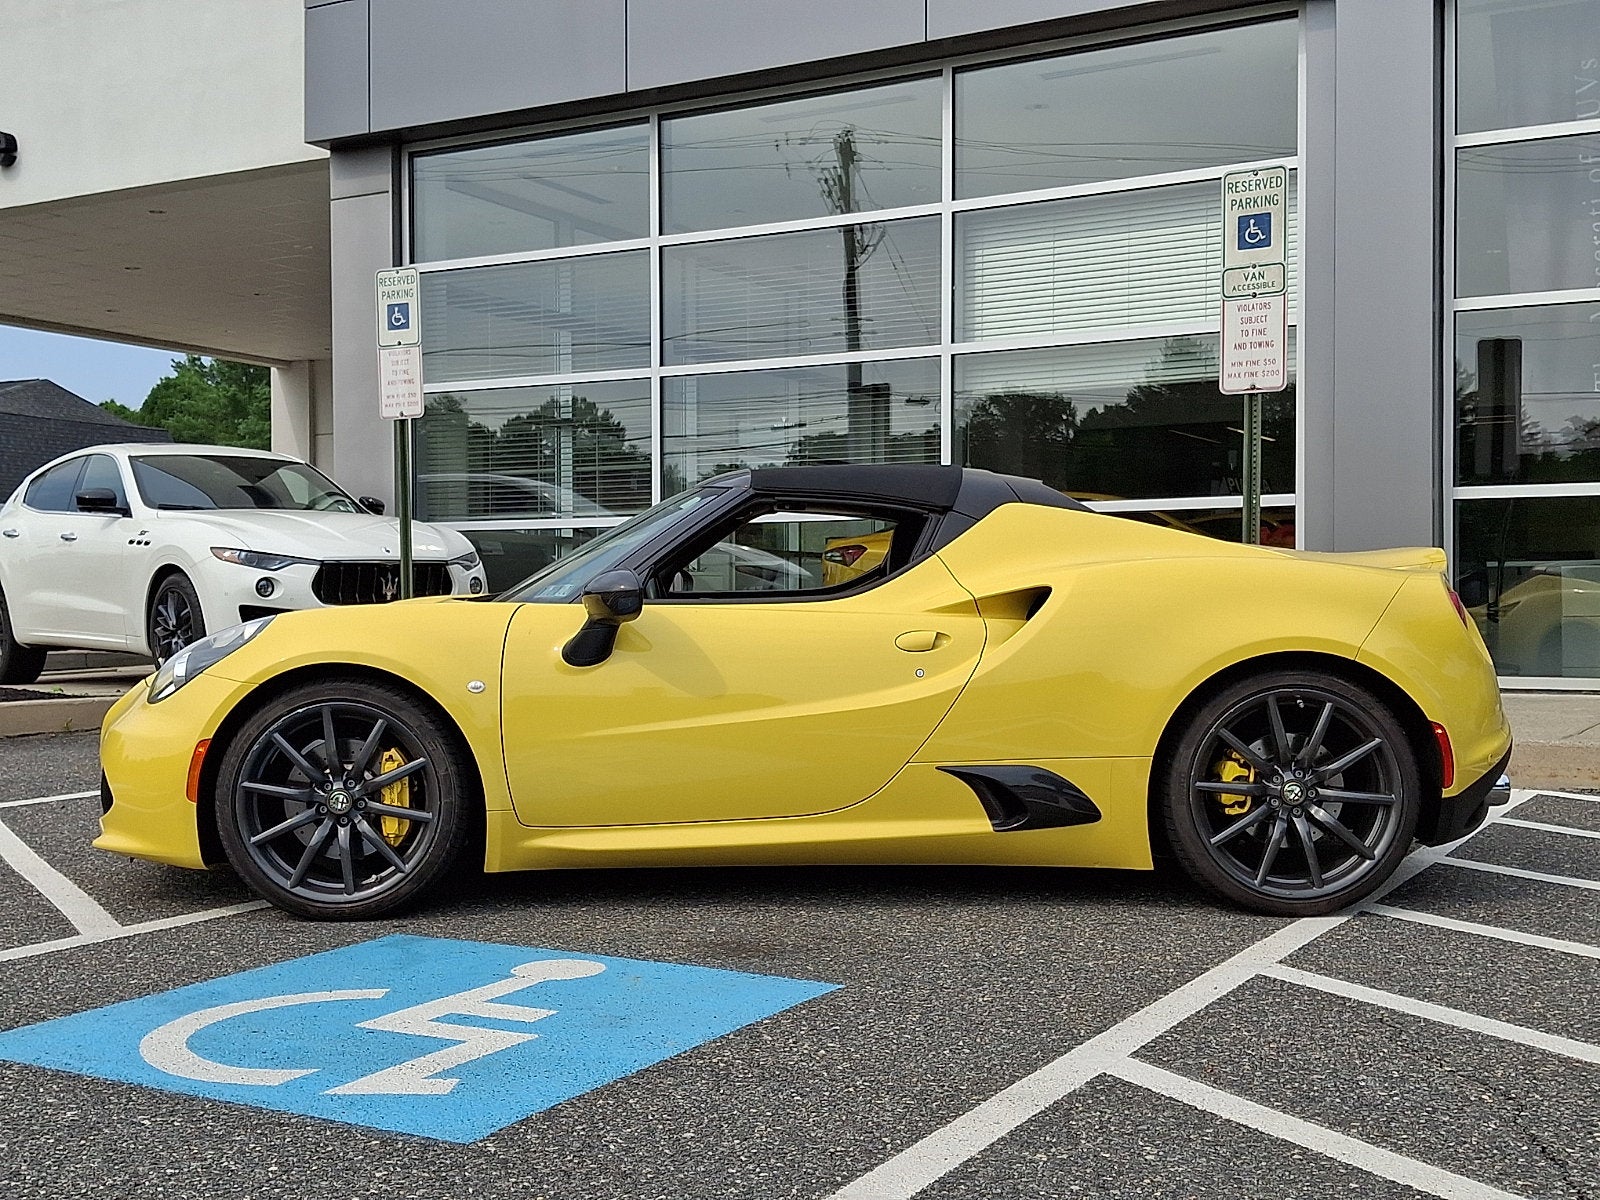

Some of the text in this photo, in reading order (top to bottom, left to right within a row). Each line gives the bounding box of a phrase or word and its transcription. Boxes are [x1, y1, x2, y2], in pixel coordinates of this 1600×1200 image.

[1227, 176, 1283, 194] RESERVED
[1231, 194, 1279, 211] PARKING
[379, 275, 415, 287] RESERVED
[1243, 271, 1265, 281] VAN
[1232, 281, 1276, 292] ACCESSIBLE
[382, 289, 414, 300] PARKING
[1237, 302, 1272, 312] VIOLATORS
[1240, 315, 1268, 325] SUBJECT
[1240, 328, 1267, 337] TO FINE
[1233, 340, 1274, 351] AND TOWING
[1245, 359, 1260, 367] FINE
[1263, 358, 1276, 366] $50
